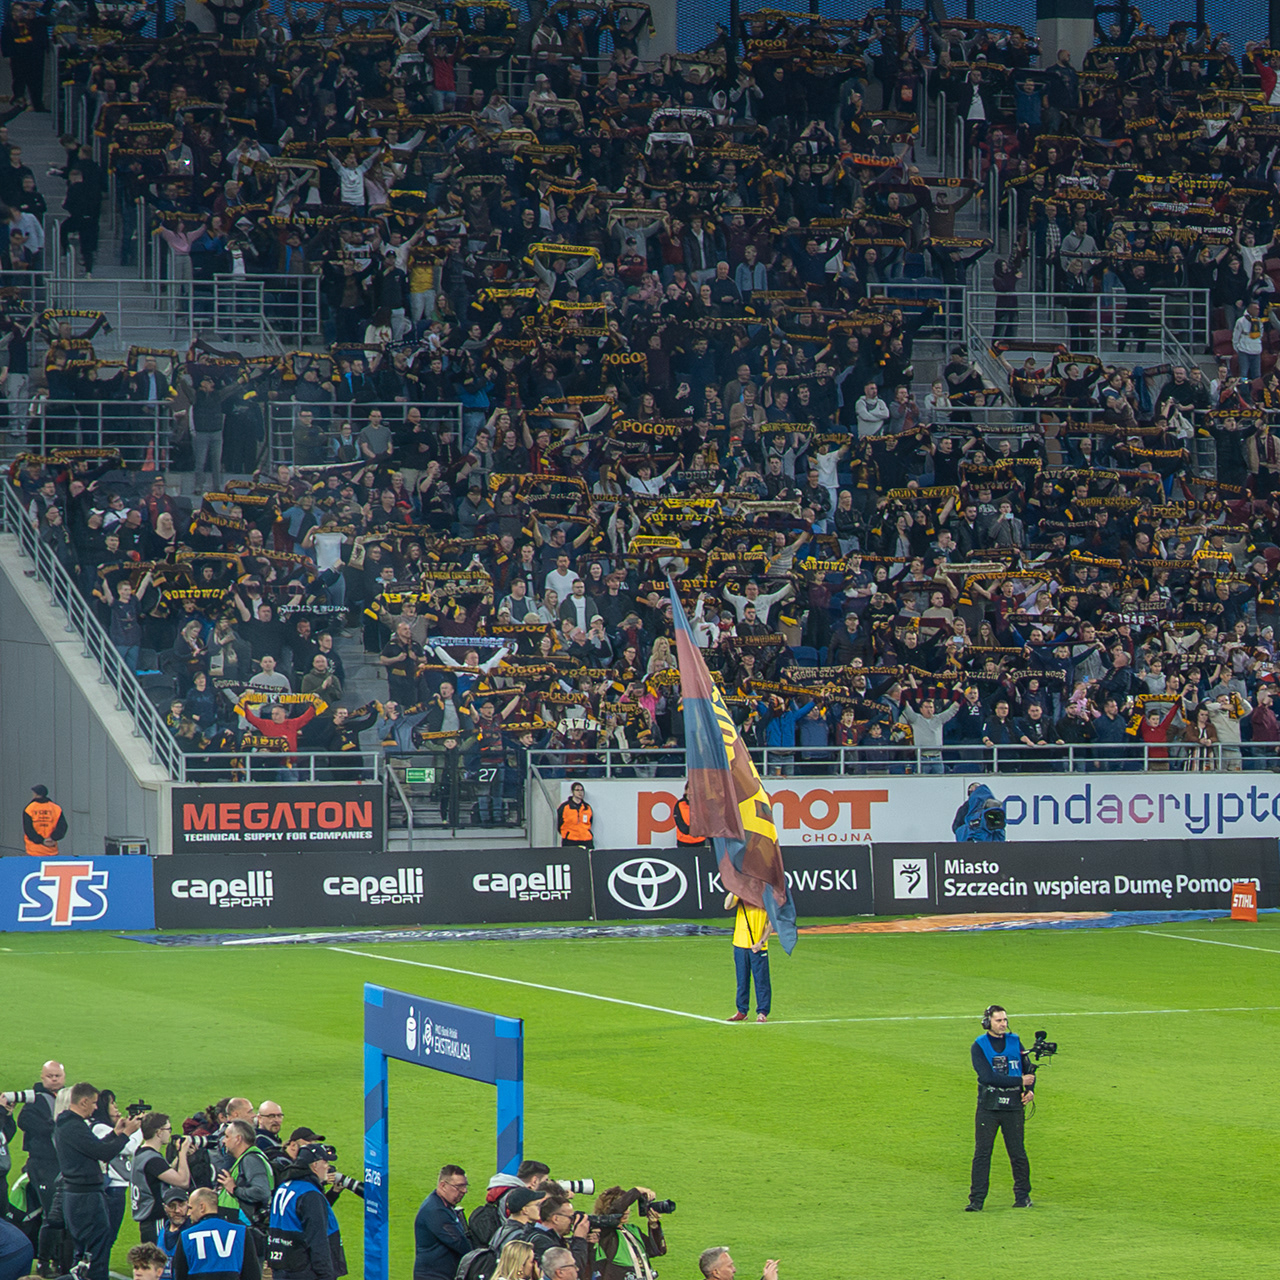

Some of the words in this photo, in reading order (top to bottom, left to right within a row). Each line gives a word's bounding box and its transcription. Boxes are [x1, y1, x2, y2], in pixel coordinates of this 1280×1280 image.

[621, 420, 677, 436] POGON
[479, 768, 497, 782] 27
[183, 801, 373, 831] MEGATON
[184, 833, 241, 842] TECHNICAL
[244, 832, 283, 842] SUPPLY
[286, 832, 307, 841] FOR
[310, 831, 373, 840] COMPANIES
[802, 832, 873, 843] CHOJNA
[944, 859, 999, 875] Miasto
[171, 870, 274, 905] capelli
[323, 867, 424, 902] capelli
[472, 864, 571, 898] capelli
[944, 878, 1027, 897] Szczecin
[1034, 876, 1109, 897] wspiera
[1115, 876, 1172, 898] Dumę
[18, 861, 109, 926] STS
[219, 897, 274, 907] SPORT
[369, 894, 424, 904] SPORT
[519, 890, 571, 900] SPORT
[1232, 894, 1255, 909] STIHL
[434, 1038, 472, 1062] EKSTRAKLASA
[272, 1187, 296, 1217] TV
[189, 1230, 238, 1260] TV
